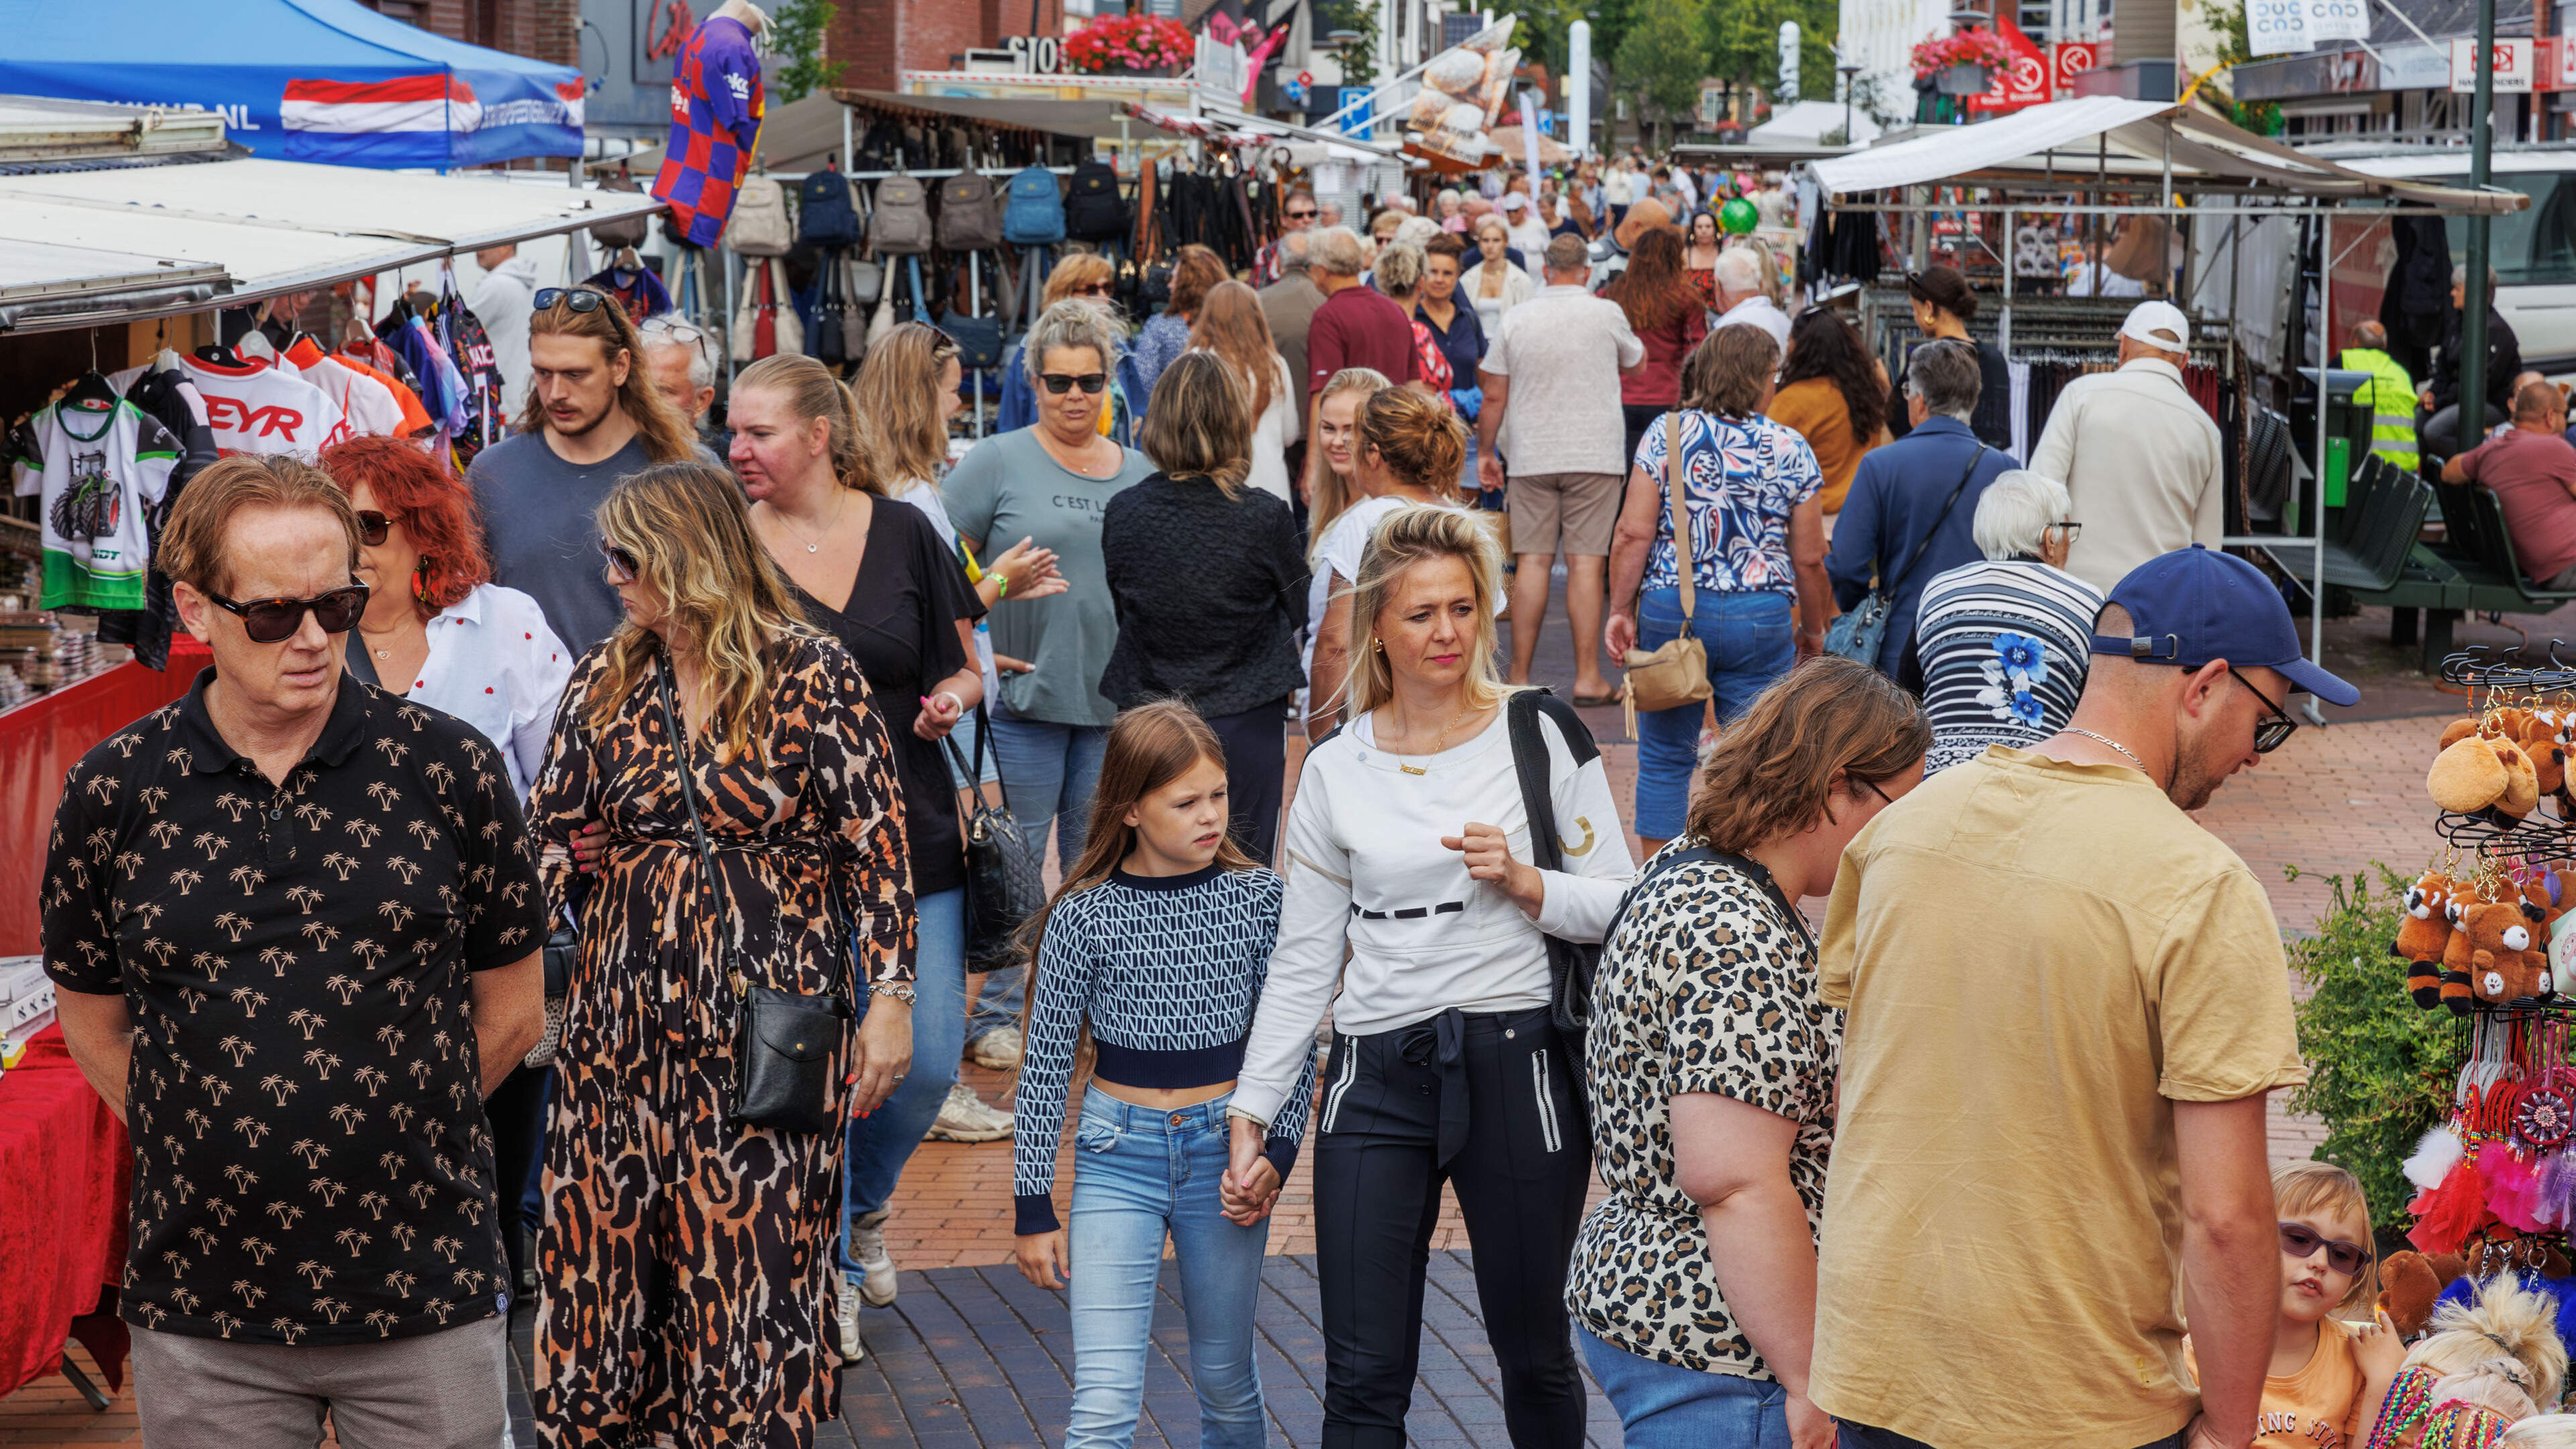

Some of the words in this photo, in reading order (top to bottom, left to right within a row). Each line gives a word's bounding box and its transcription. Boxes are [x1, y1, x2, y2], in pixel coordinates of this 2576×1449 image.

[201, 394, 303, 443] EYR
[1095, 500, 1106, 513] L
[91, 549, 121, 560] NDT
[2256, 1411, 2296, 1437] ING
